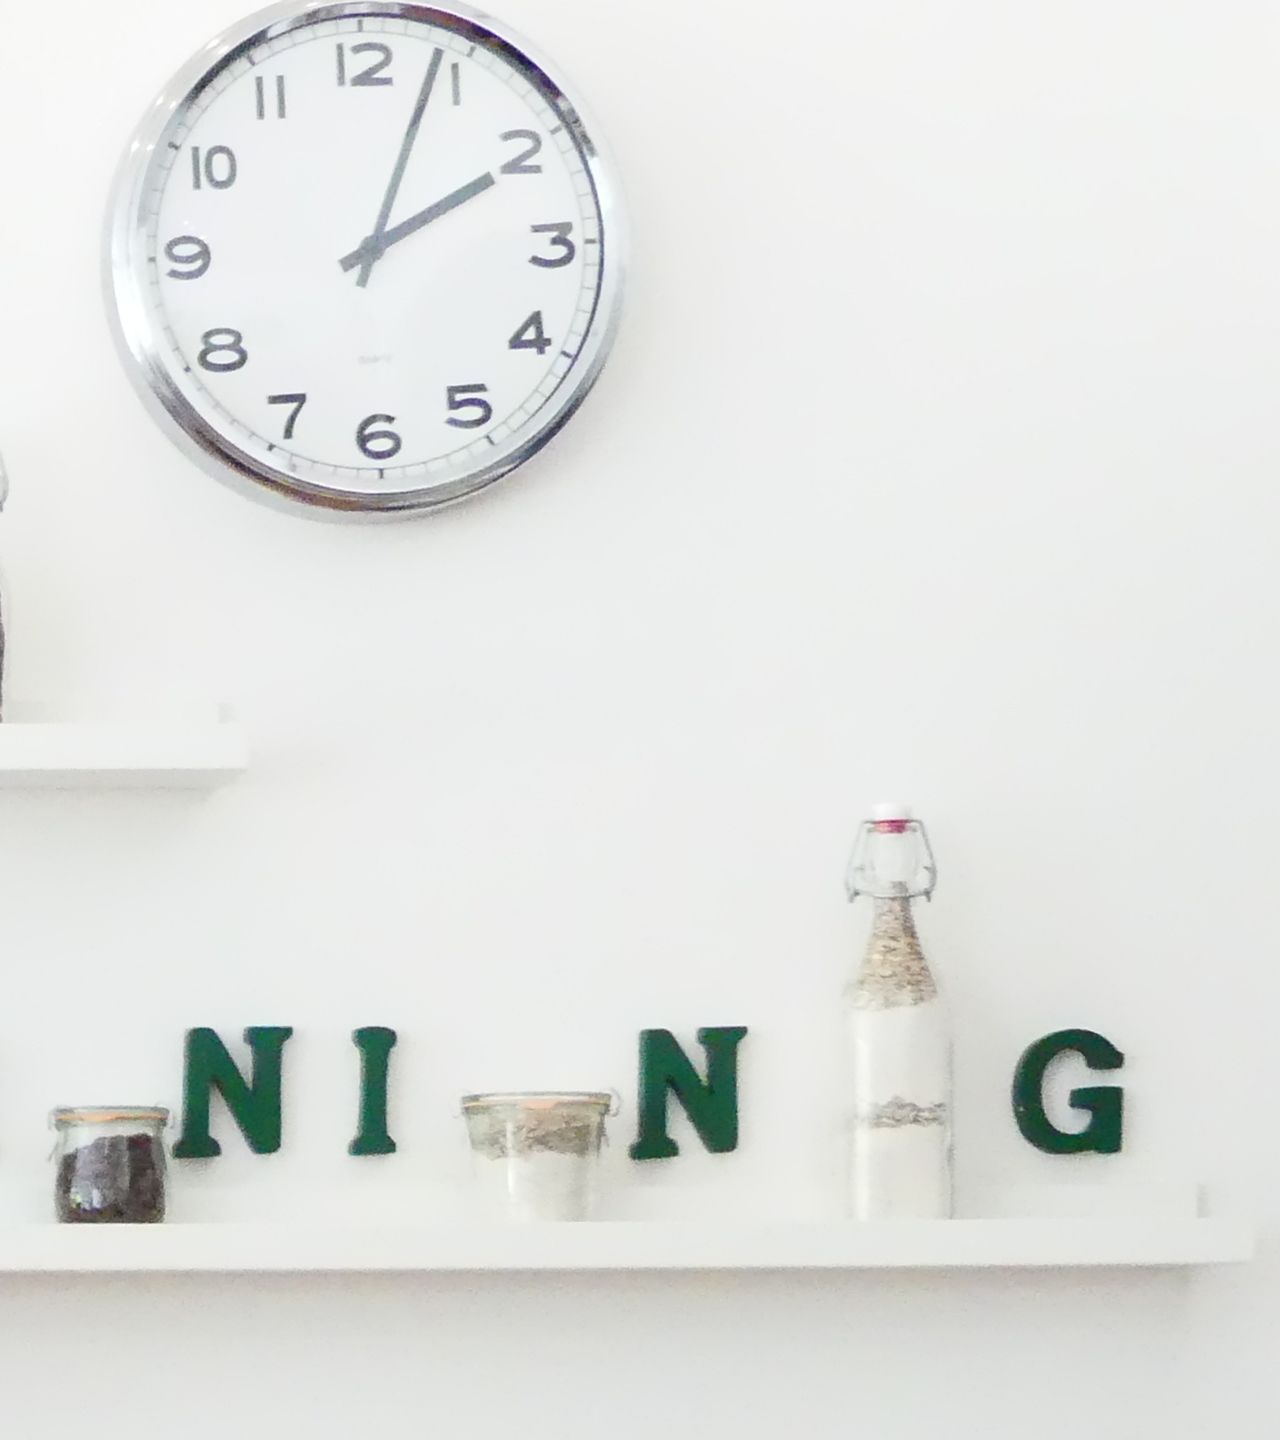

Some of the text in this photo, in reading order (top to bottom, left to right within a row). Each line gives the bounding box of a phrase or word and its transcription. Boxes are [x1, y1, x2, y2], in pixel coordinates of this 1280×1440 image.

[336, 42, 394, 87] 12
[450, 62, 461, 107] 1
[255, 75, 286, 120] 11
[191, 145, 238, 190] 10
[498, 129, 543, 175] 2
[164, 235, 212, 281] 9
[527, 221, 576, 269] 3
[196, 327, 249, 373] 8
[507, 310, 553, 356] 4
[266, 392, 308, 440] 7
[445, 383, 494, 430] 5
[355, 413, 403, 461] 6
